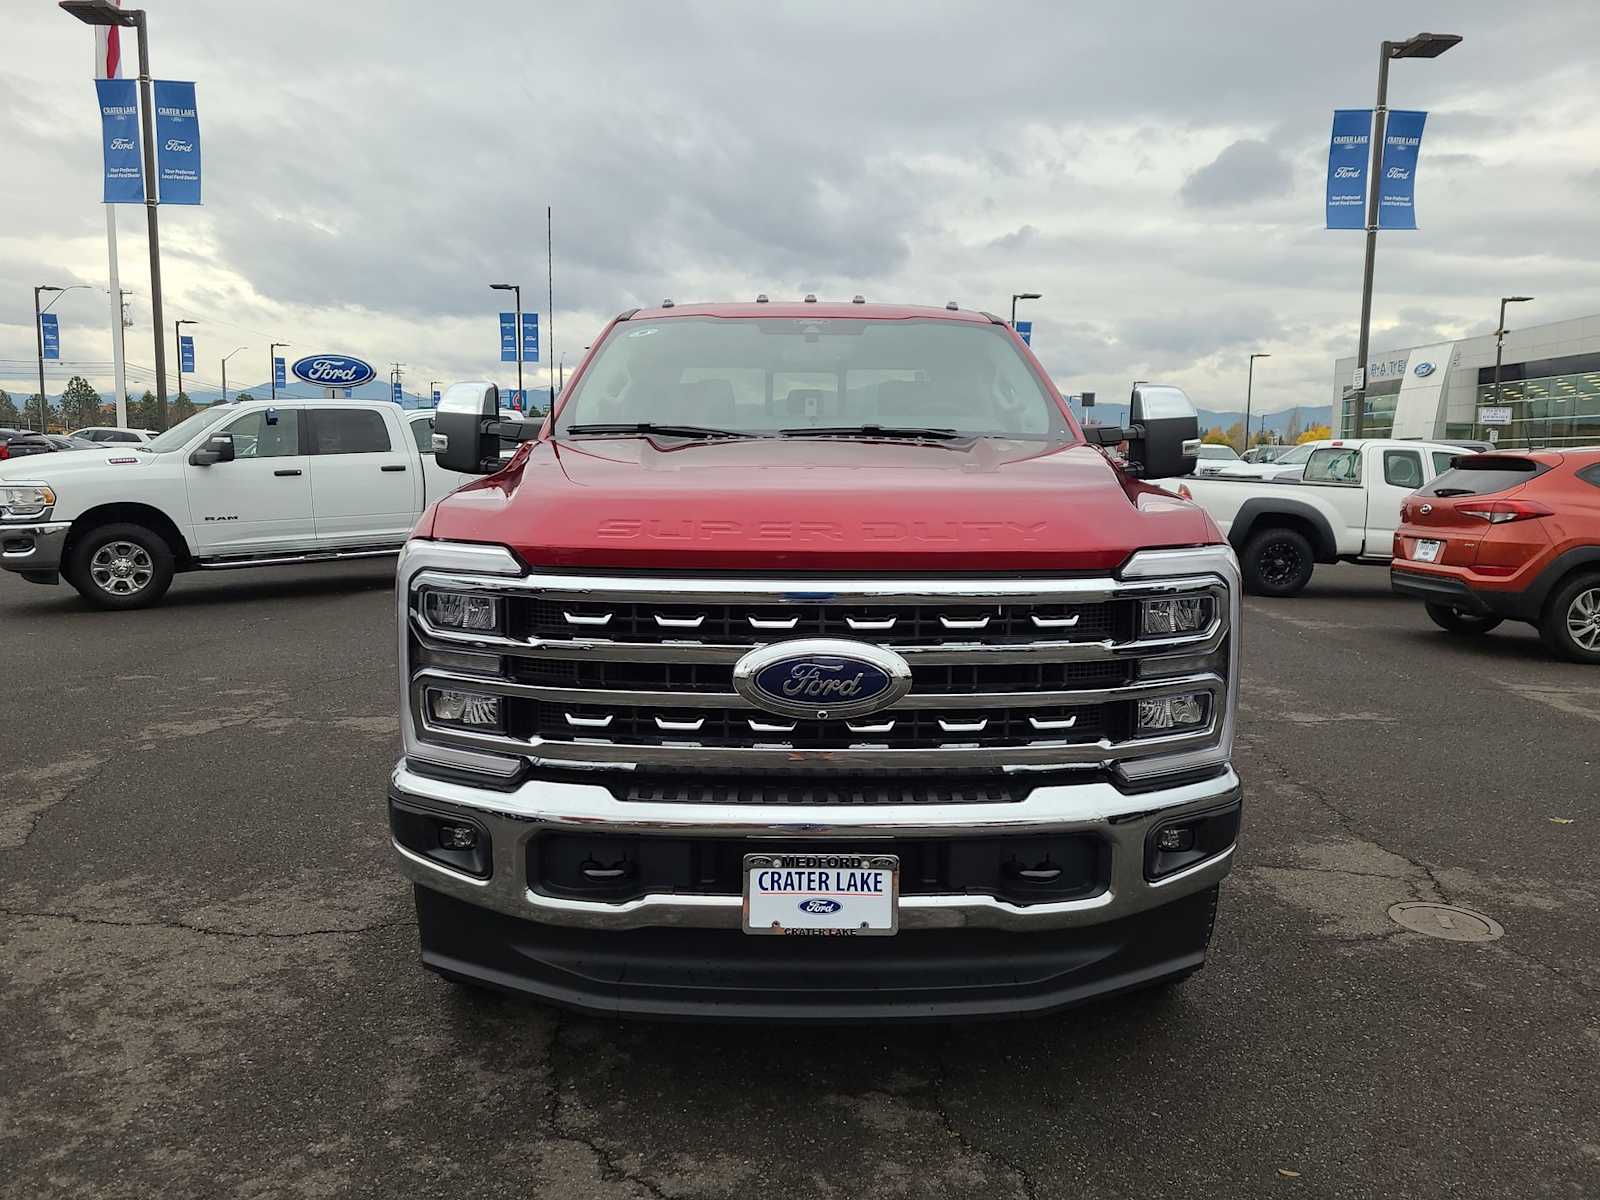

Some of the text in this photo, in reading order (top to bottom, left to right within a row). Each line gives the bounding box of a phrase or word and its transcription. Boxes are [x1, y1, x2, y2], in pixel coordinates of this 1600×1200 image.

[103, 106, 136, 114] CRATER LAKE
[158, 107, 195, 117] CRATER LAKE
[110, 138, 135, 150] Ford
[165, 139, 193, 152] Ford
[1334, 135, 1368, 144] CRATER LAKE
[1388, 136, 1419, 145] CRATER LAKE
[1335, 166, 1361, 178] Ford
[1387, 167, 1410, 179] Ford
[308, 359, 357, 380] Ford
[596, 518, 1048, 543] SUPER DUTY
[783, 663, 864, 697] Ford
[781, 855, 862, 869] MEDFORD
[758, 871, 883, 893] CRATER LAKE
[806, 900, 834, 913] Ford
[784, 928, 857, 937] CRATER LAKE
